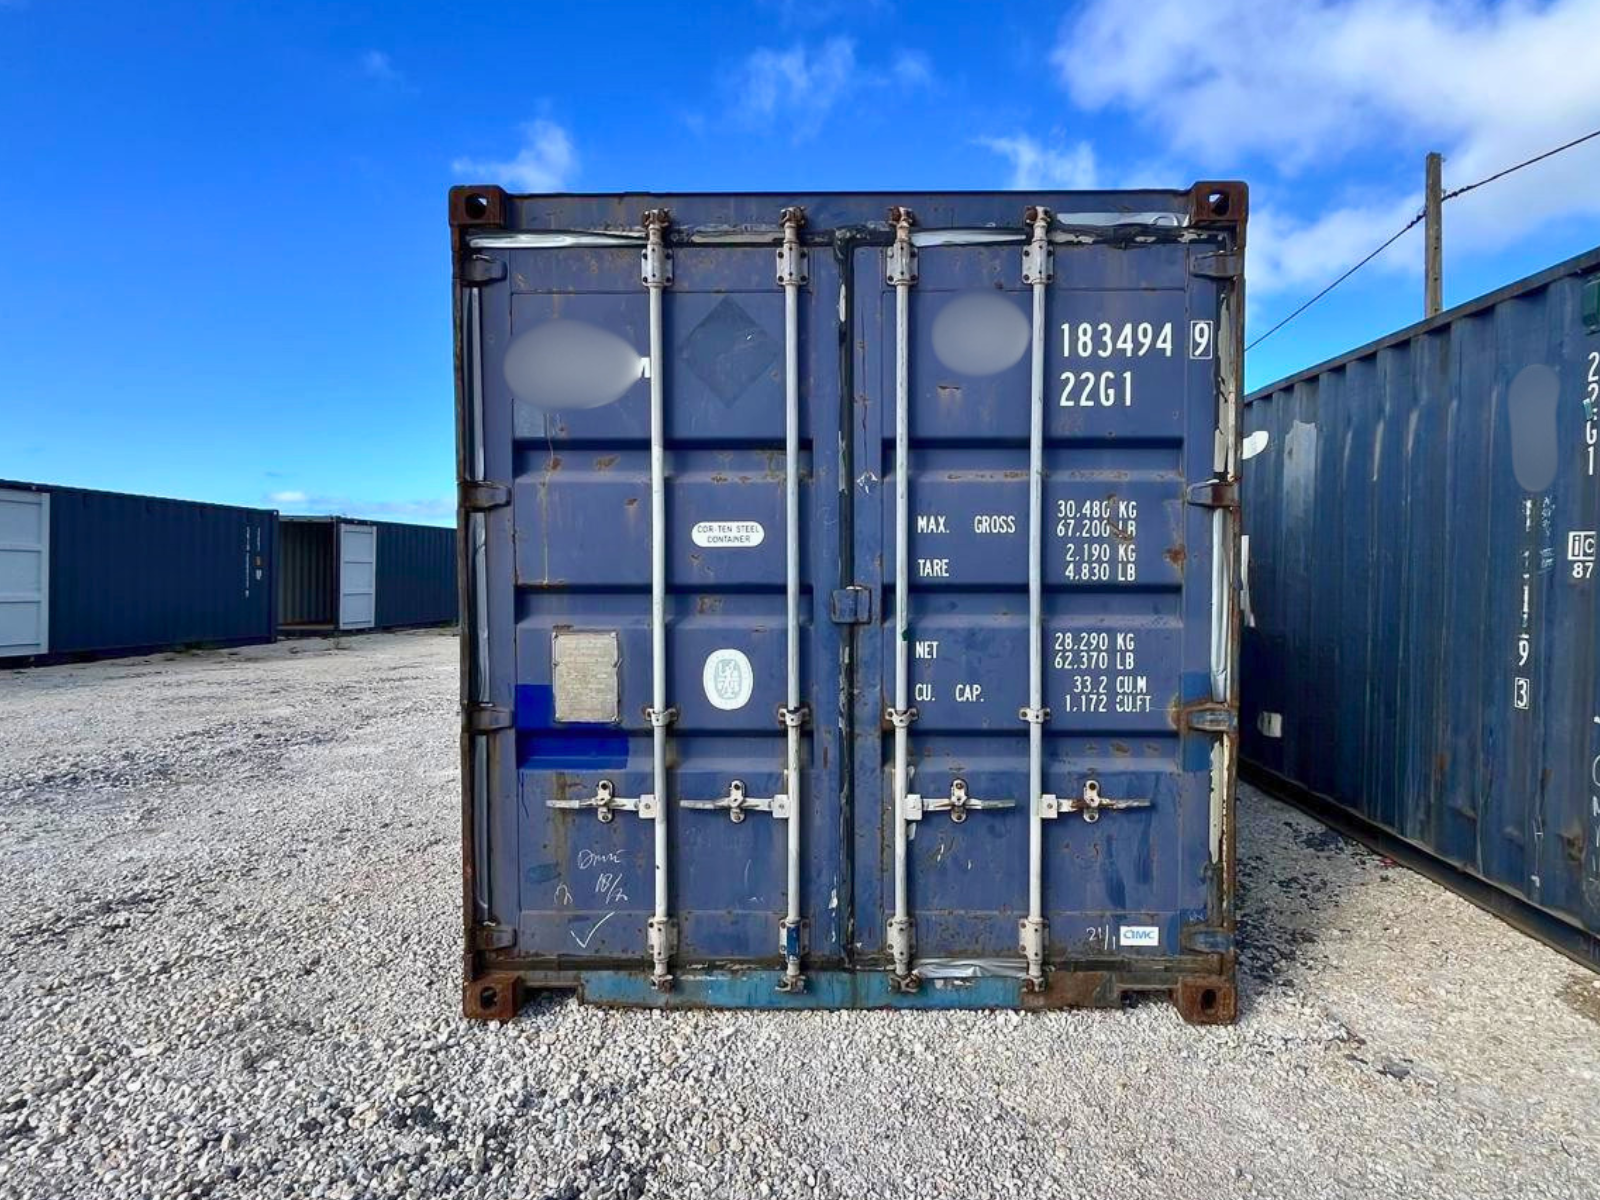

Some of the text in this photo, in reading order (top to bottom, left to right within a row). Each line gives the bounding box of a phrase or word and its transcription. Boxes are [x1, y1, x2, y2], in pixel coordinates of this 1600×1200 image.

[1060, 322, 1210, 358] 183494 9
[1059, 370, 1132, 407] 22G1
[1118, 500, 1137, 519] KG
[735, 524, 761, 534] STEEL
[917, 514, 1016, 534] MAX. GROSS
[707, 534, 752, 544] CONTAINER
[1118, 543, 1136, 562] KG
[917, 558, 950, 577] TARE
[1117, 562, 1136, 581] LB
[1572, 561, 1594, 579] 87
[915, 641, 939, 659] NET
[1116, 632, 1135, 651] KG
[1116, 651, 1135, 670] LB
[915, 683, 985, 703] CU. CAP.
[1073, 675, 1108, 694] 33.2
[1123, 929, 1155, 940] CIMC
